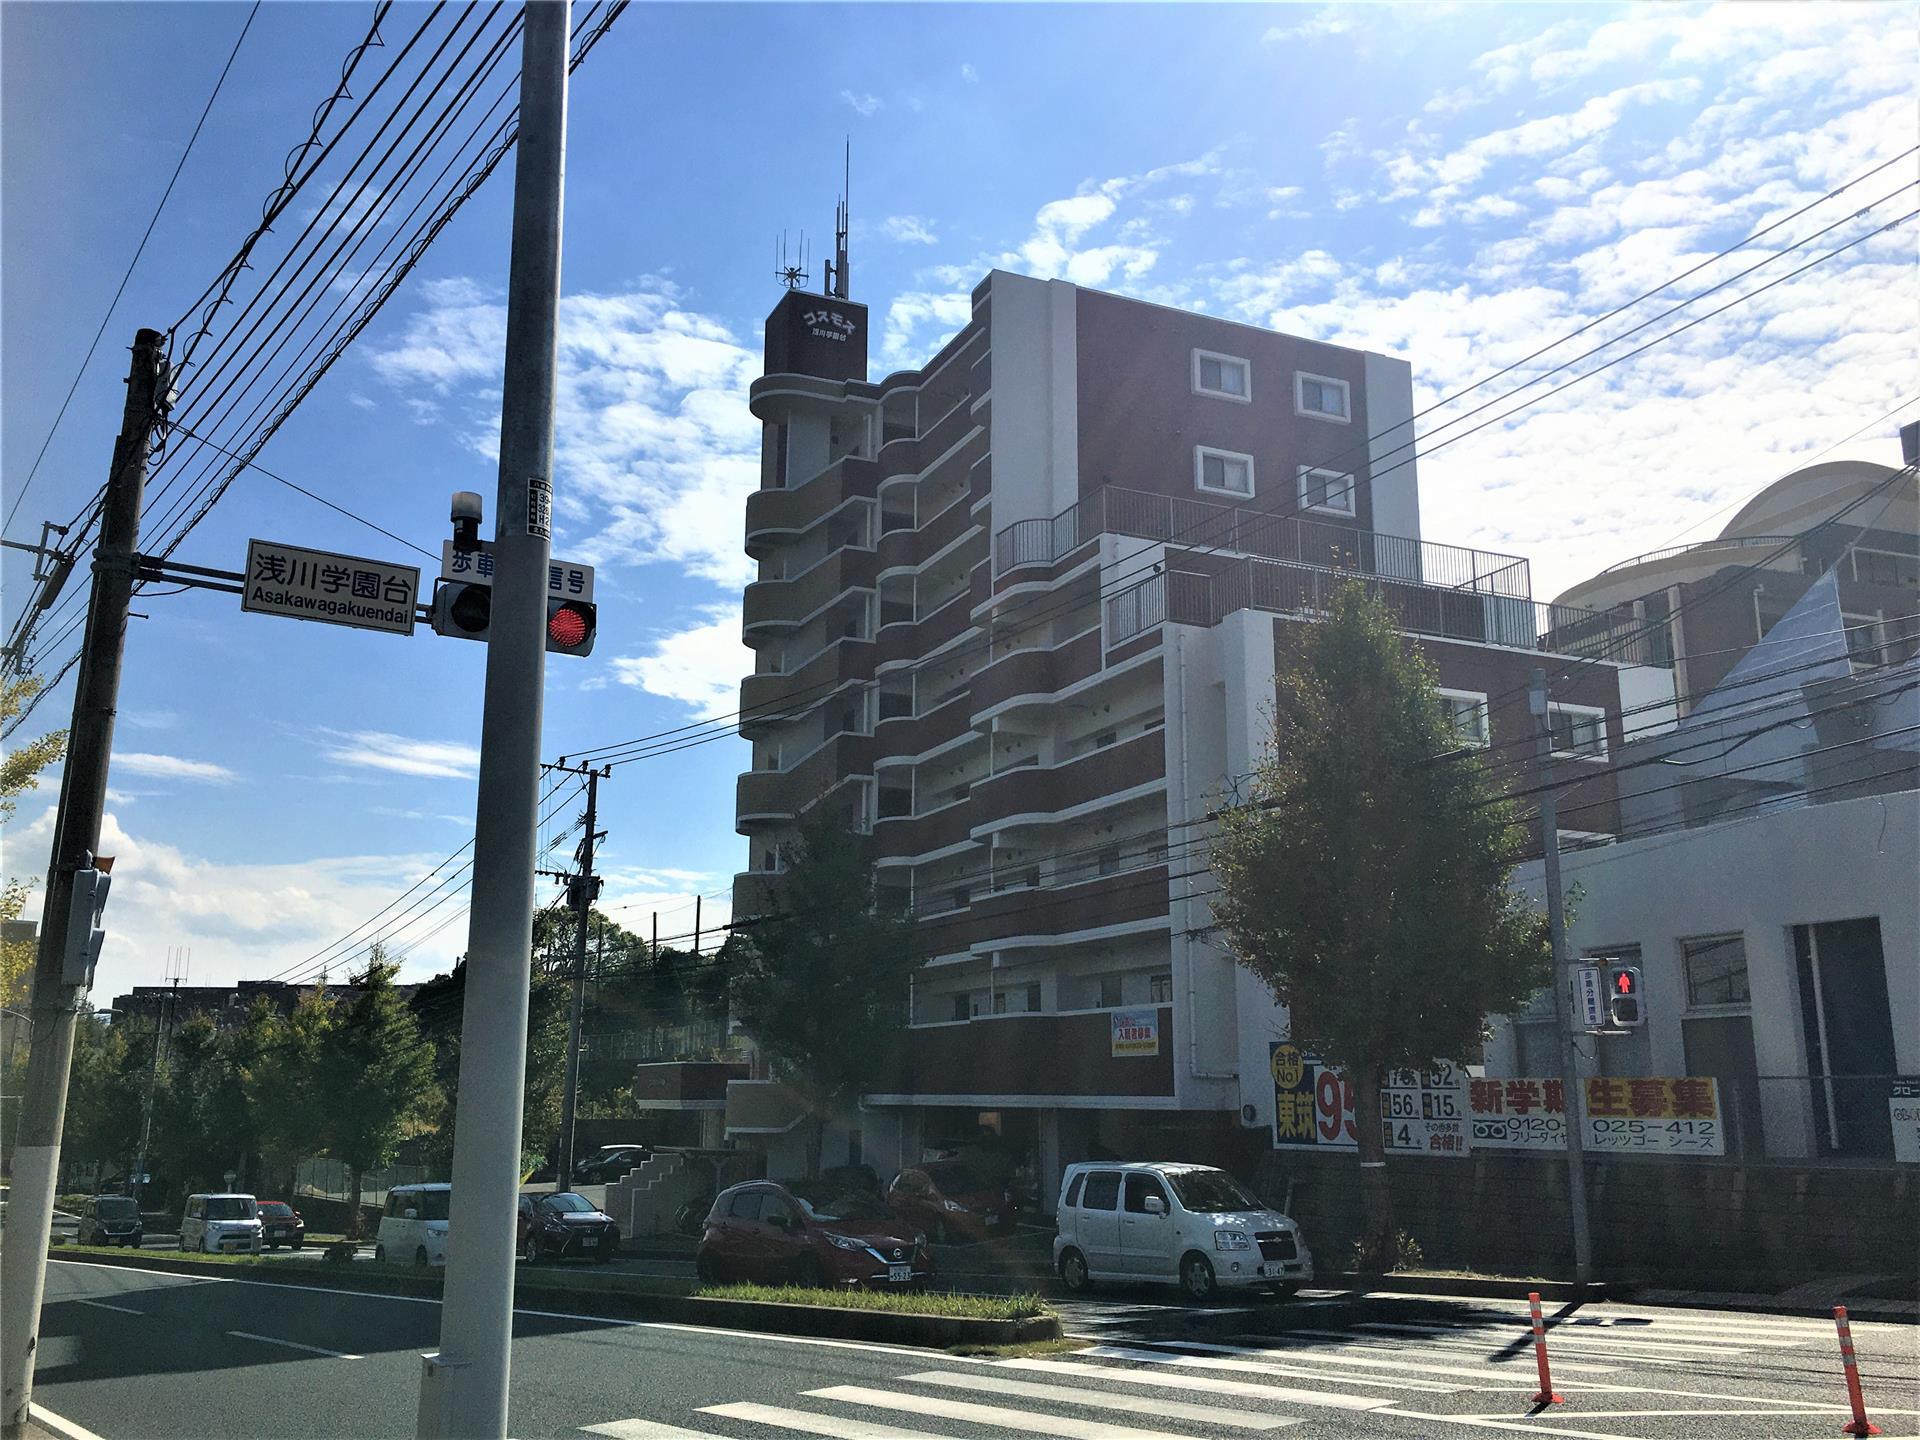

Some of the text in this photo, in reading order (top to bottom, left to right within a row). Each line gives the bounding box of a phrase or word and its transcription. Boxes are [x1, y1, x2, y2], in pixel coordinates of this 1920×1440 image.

[254, 553, 412, 605] 浅川学園台
[252, 586, 409, 625] Asakawagakuendai
[1276, 1050, 1299, 1067] 合格
